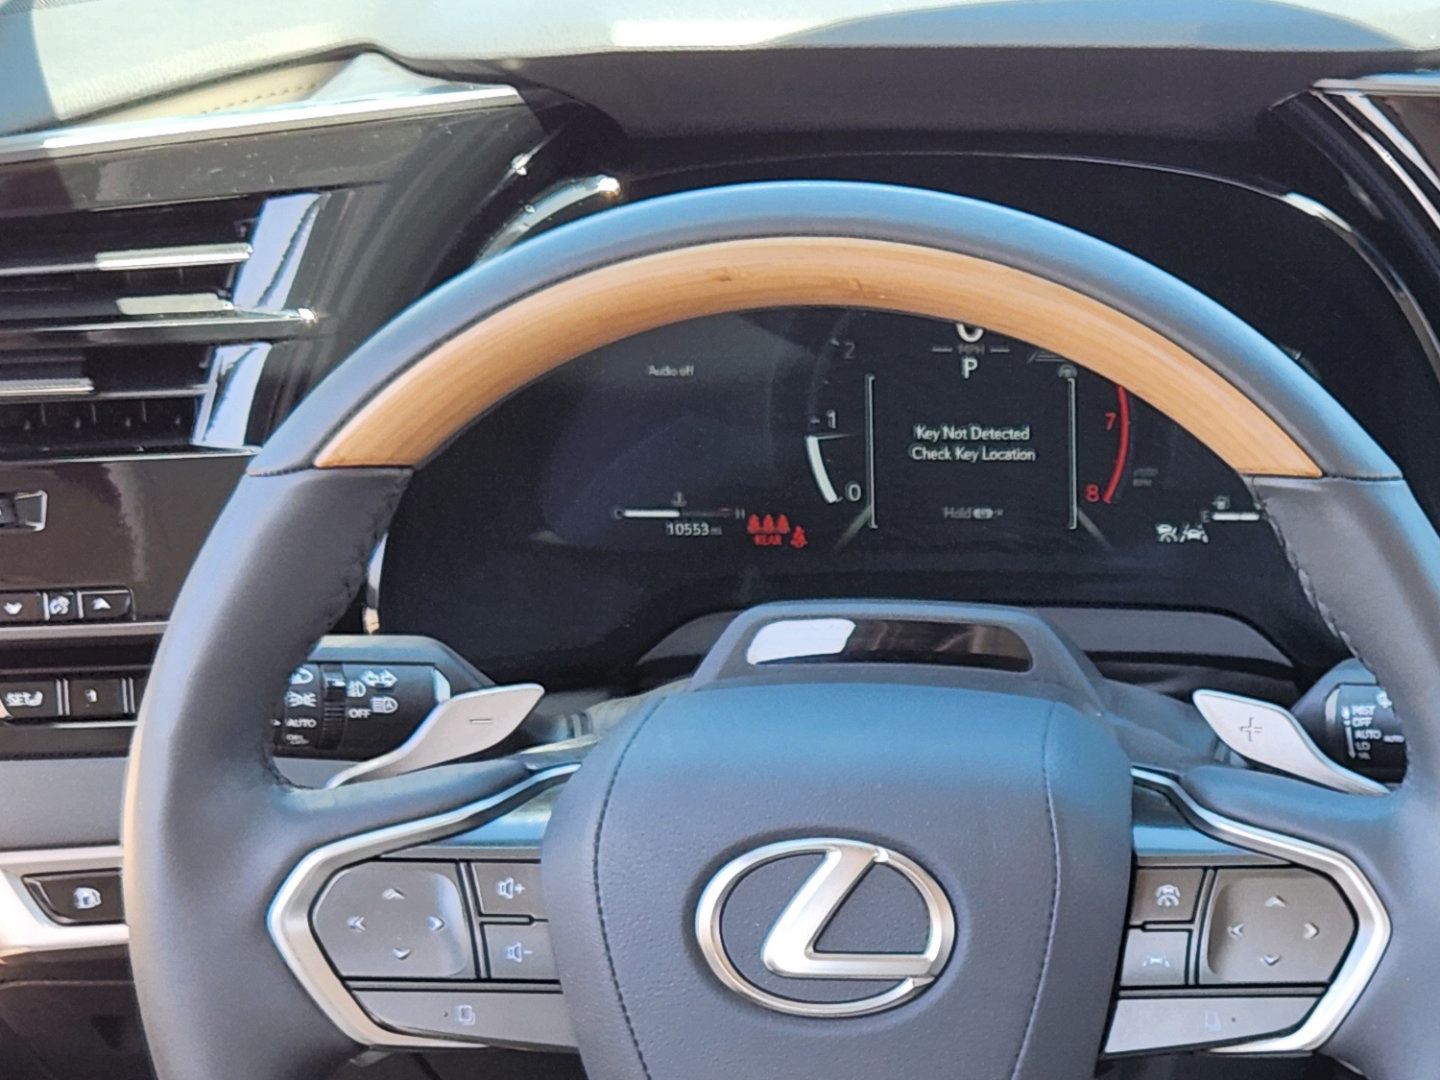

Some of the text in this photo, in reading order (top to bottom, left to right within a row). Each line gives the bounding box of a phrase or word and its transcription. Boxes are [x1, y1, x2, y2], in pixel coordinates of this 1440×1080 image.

[844, 342, 856, 359] 2
[648, 365, 694, 377] Audio off
[961, 357, 978, 379] P
[826, 410, 837, 429] 1
[1105, 412, 1116, 431] 7
[914, 424, 1030, 442] Key Not Detected
[910, 445, 1036, 463] Check Key Location
[845, 483, 861, 501] 0
[1085, 484, 1100, 502] 8
[1201, 510, 1210, 523] E
[665, 522, 710, 536] 10553
[753, 534, 782, 546] REAR
[349, 708, 371, 719] OFF
[285, 718, 317, 728] AUTO
[1352, 716, 1373, 727] OFF
[1354, 729, 1382, 740] AUTO
[1355, 741, 1371, 751] LO
